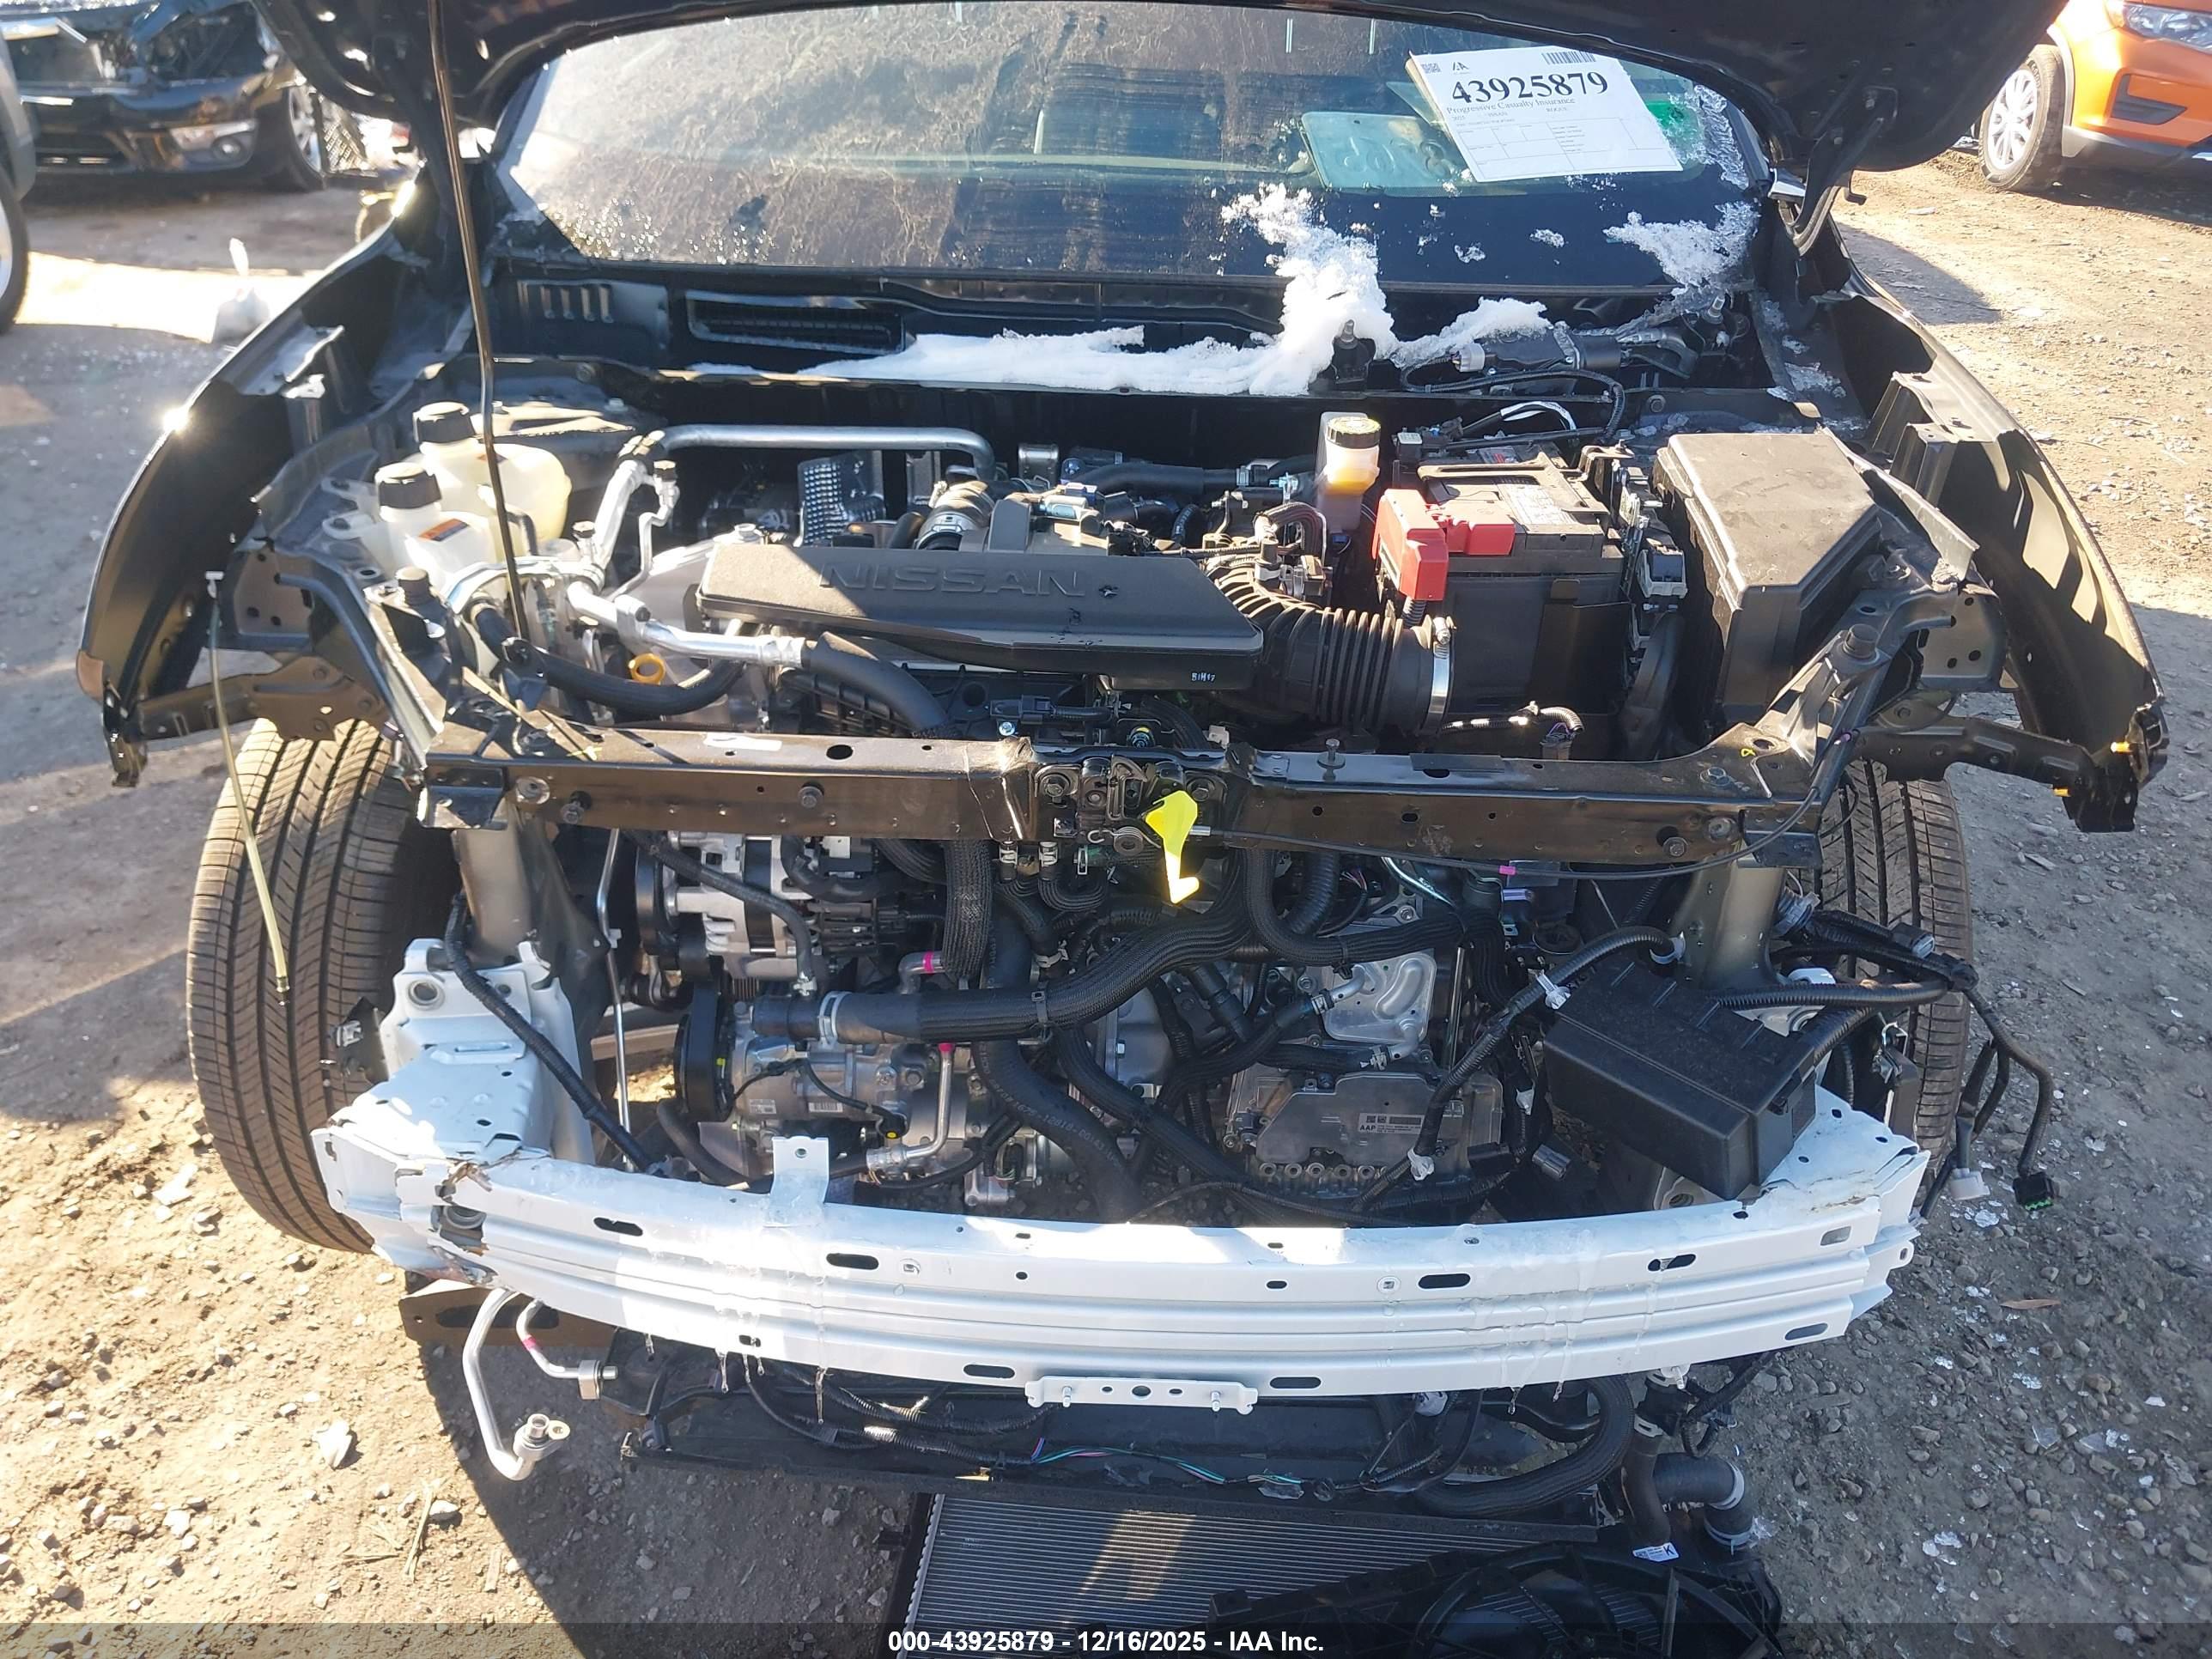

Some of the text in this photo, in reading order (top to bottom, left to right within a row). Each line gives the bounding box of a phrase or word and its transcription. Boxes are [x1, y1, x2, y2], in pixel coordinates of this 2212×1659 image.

[1452, 71, 1608, 103] 43925879
[1446, 98, 1576, 115] Progressive Casualty Insurance
[819, 562, 1085, 596] NISSAN
[1662, 1545, 1675, 1556] K
